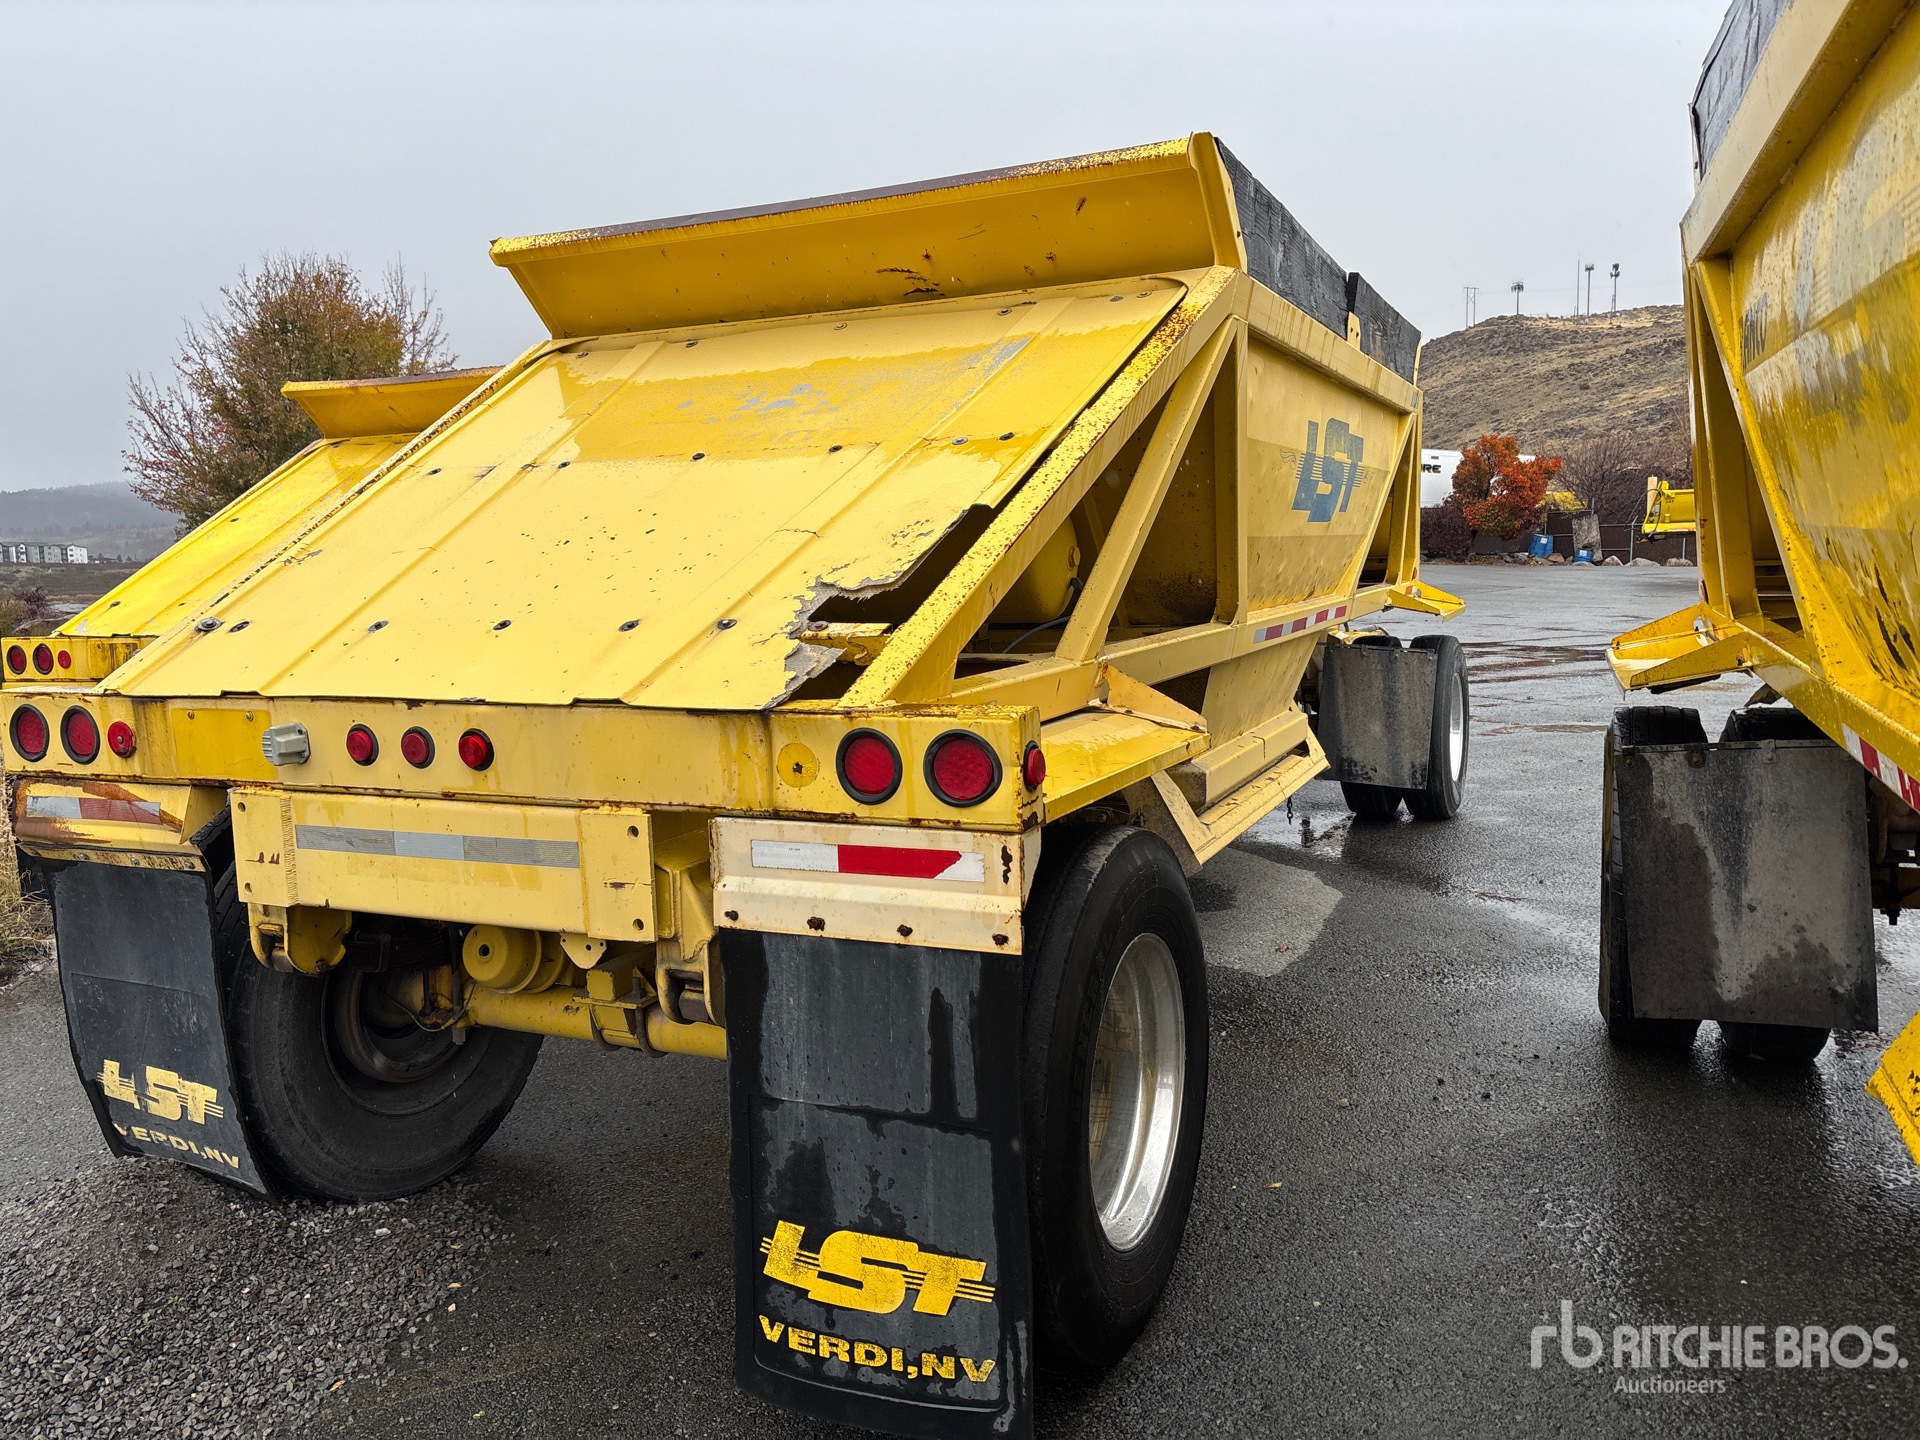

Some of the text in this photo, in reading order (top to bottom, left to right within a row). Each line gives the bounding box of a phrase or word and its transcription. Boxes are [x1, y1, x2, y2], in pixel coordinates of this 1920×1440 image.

[1421, 463, 1441, 474] RE
[97, 1059, 223, 1125] LST
[760, 1220, 995, 1316] LST
[758, 1314, 996, 1383] VERDI,NV
